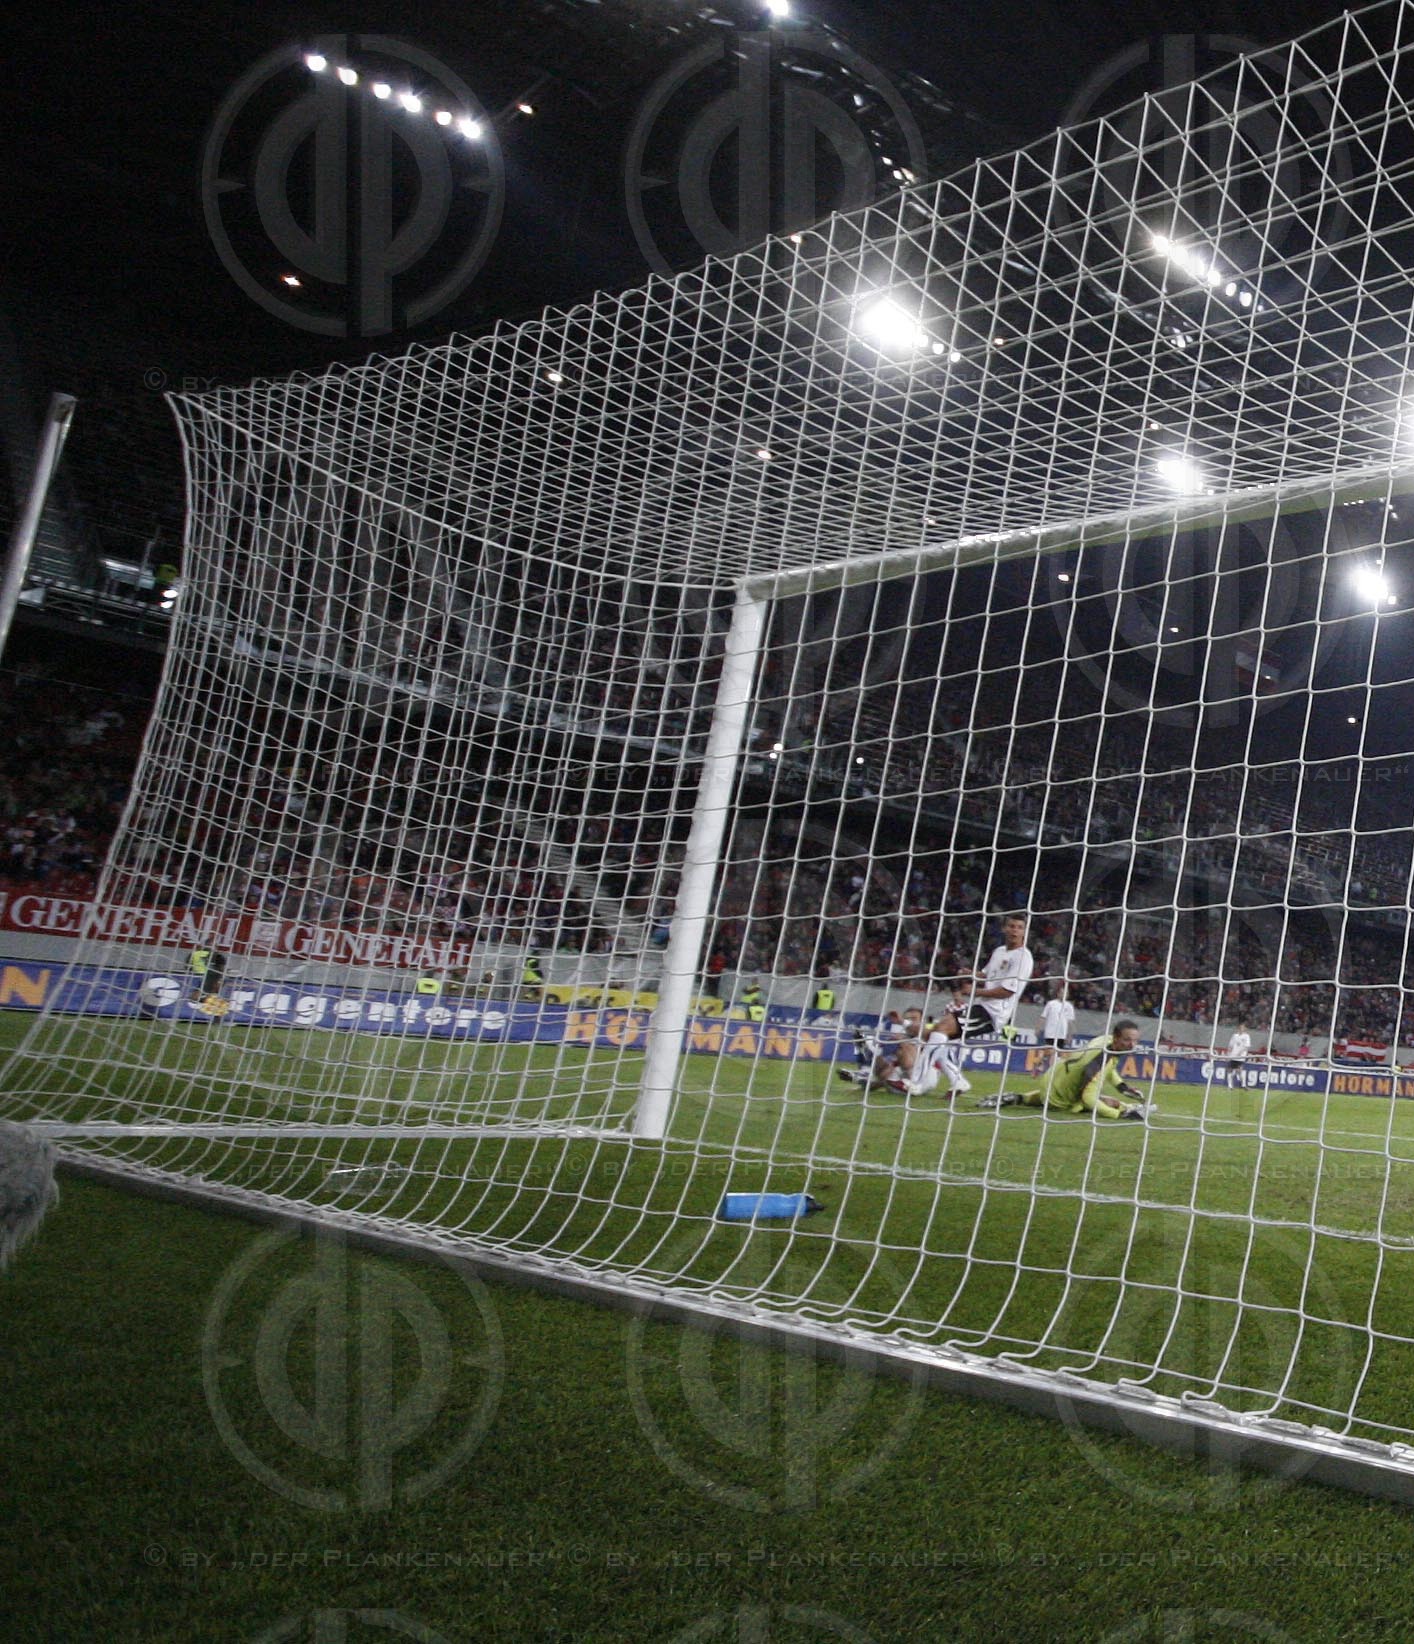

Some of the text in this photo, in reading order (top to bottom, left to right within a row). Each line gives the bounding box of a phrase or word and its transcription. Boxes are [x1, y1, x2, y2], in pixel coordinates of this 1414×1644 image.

[10, 895, 238, 947] GENERALI
[284, 924, 470, 970] GENERALI
[140, 977, 506, 1030] Gragentore
[564, 1012, 825, 1059] HÖMANN
